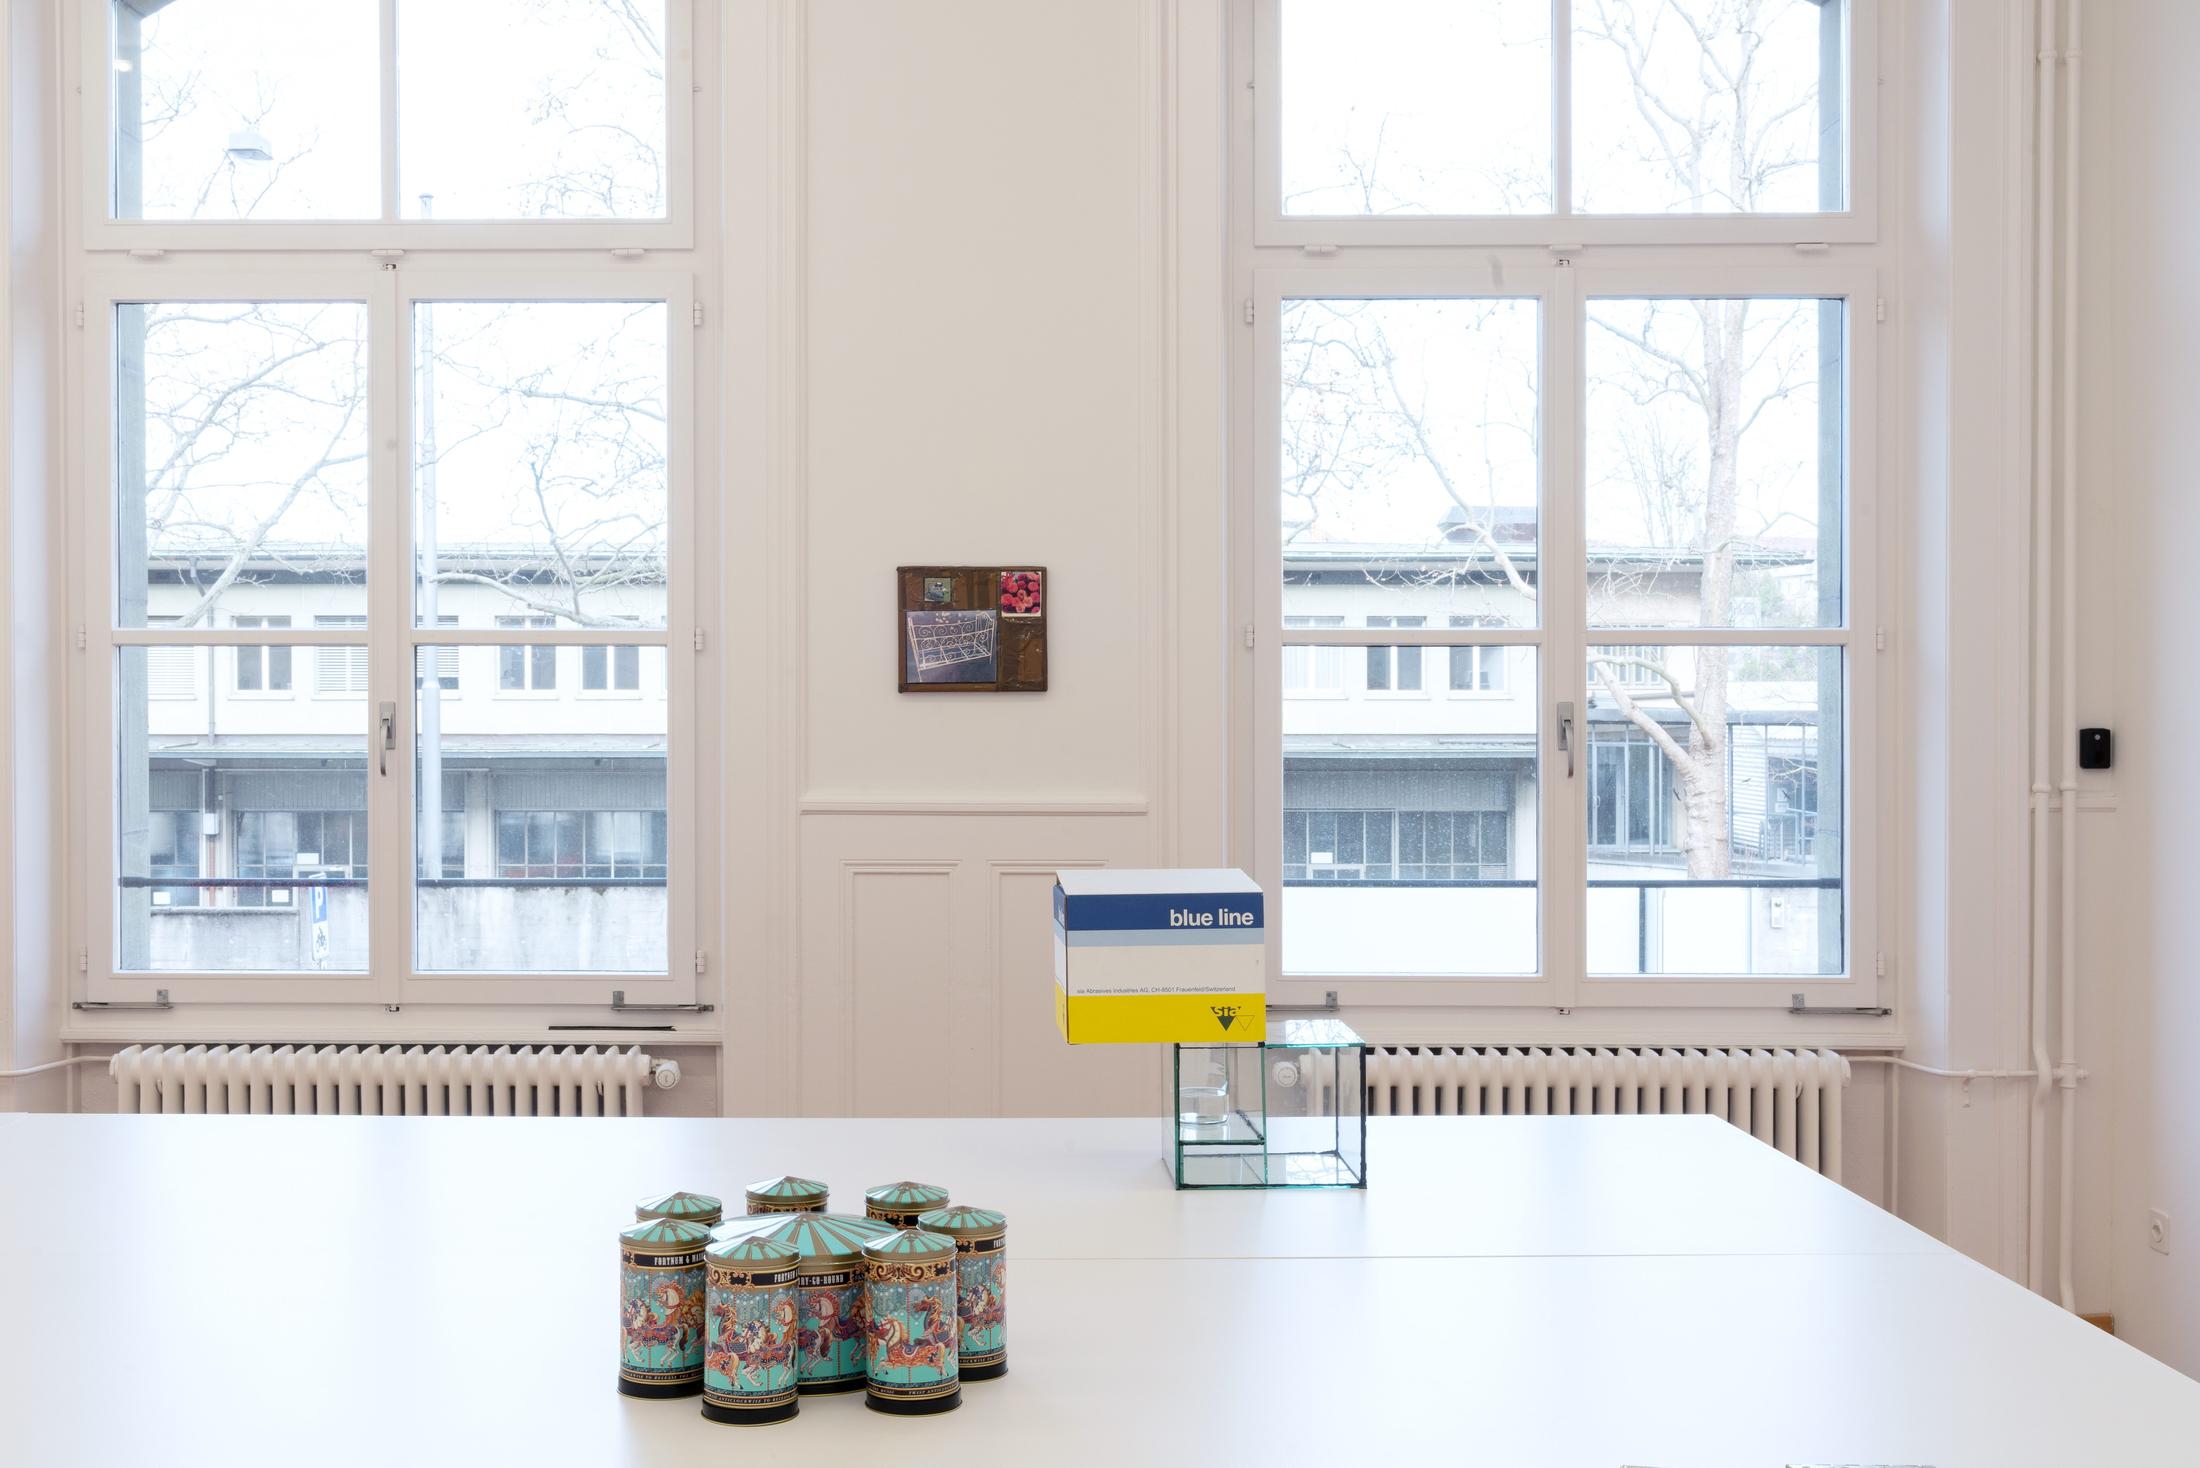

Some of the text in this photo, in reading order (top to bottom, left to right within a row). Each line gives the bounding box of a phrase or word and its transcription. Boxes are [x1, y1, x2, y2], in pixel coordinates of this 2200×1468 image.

[315, 885, 325, 919] P
[1169, 907, 1254, 927] blue line
[654, 1255, 684, 1266] FORTNUM
[685, 1255, 690, 1264] &
